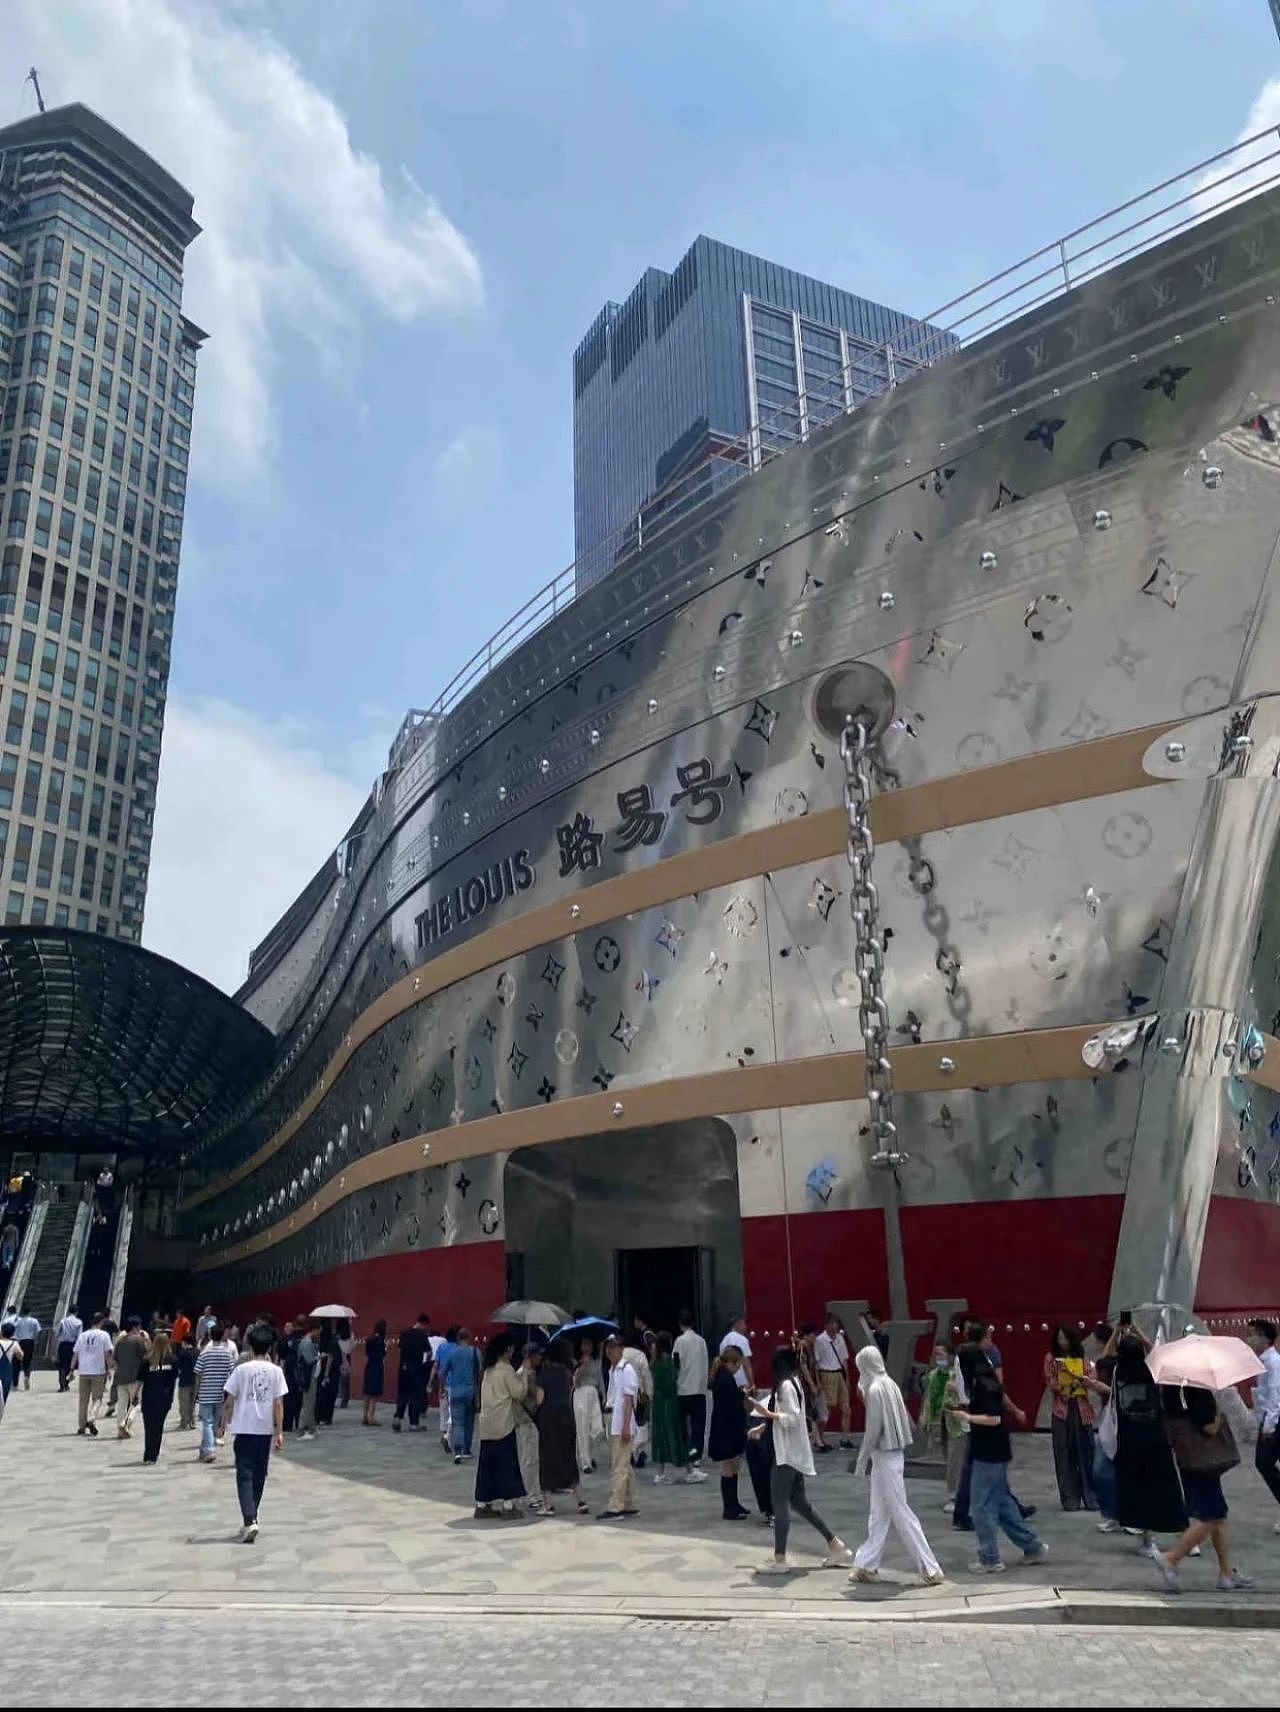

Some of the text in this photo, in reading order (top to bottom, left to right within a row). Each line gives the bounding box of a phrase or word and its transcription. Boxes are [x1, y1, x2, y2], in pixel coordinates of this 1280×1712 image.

[556, 756, 732, 878] 路易号
[414, 849, 537, 951] THE LOUIS
